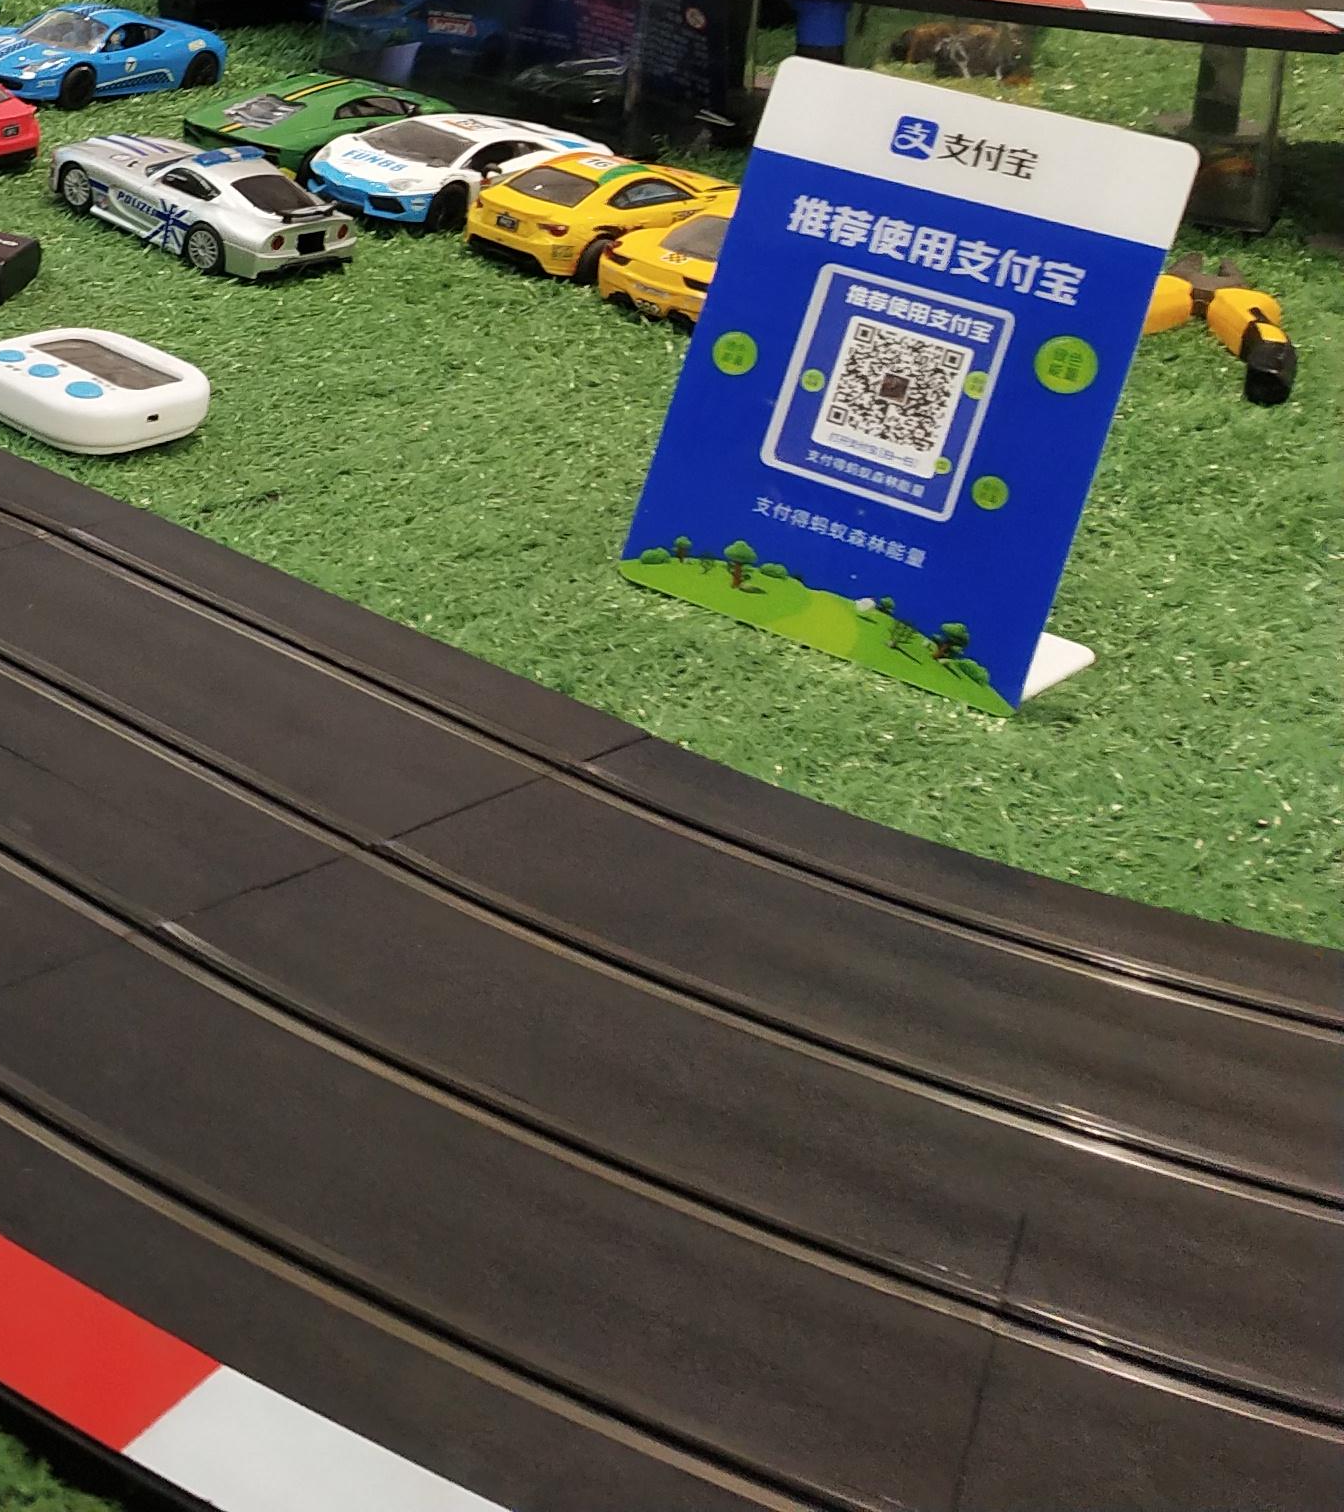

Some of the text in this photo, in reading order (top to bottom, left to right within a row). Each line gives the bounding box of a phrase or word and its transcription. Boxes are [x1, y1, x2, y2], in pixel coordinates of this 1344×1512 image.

[937, 132, 1039, 180] 支付宝
[786, 194, 1087, 306] 推荐使用支付宝
[845, 285, 995, 342] 推荐使用支付宝
[752, 495, 928, 569] 支付得蚂蚁森林能量
